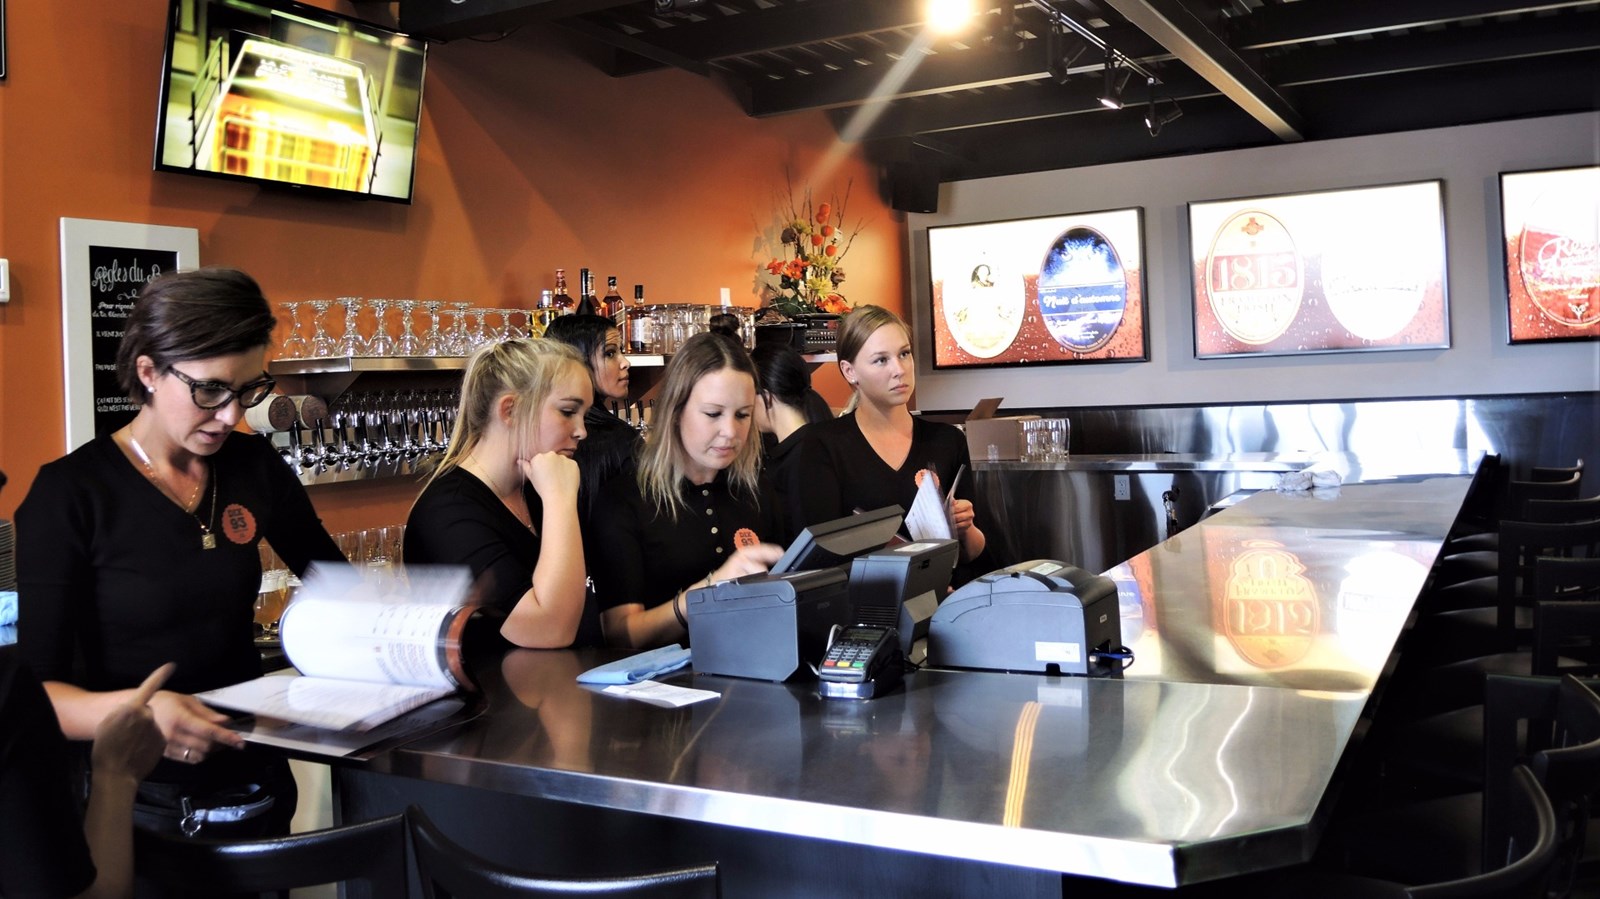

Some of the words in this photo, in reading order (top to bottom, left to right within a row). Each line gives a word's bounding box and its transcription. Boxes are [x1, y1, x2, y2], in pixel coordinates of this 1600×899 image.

[92, 258, 128, 293] Règles
[129, 257, 145, 283] du
[1215, 254, 1296, 290] 1815
[1043, 295, 1070, 309] Nuit
[1071, 294, 1121, 304] d'automne
